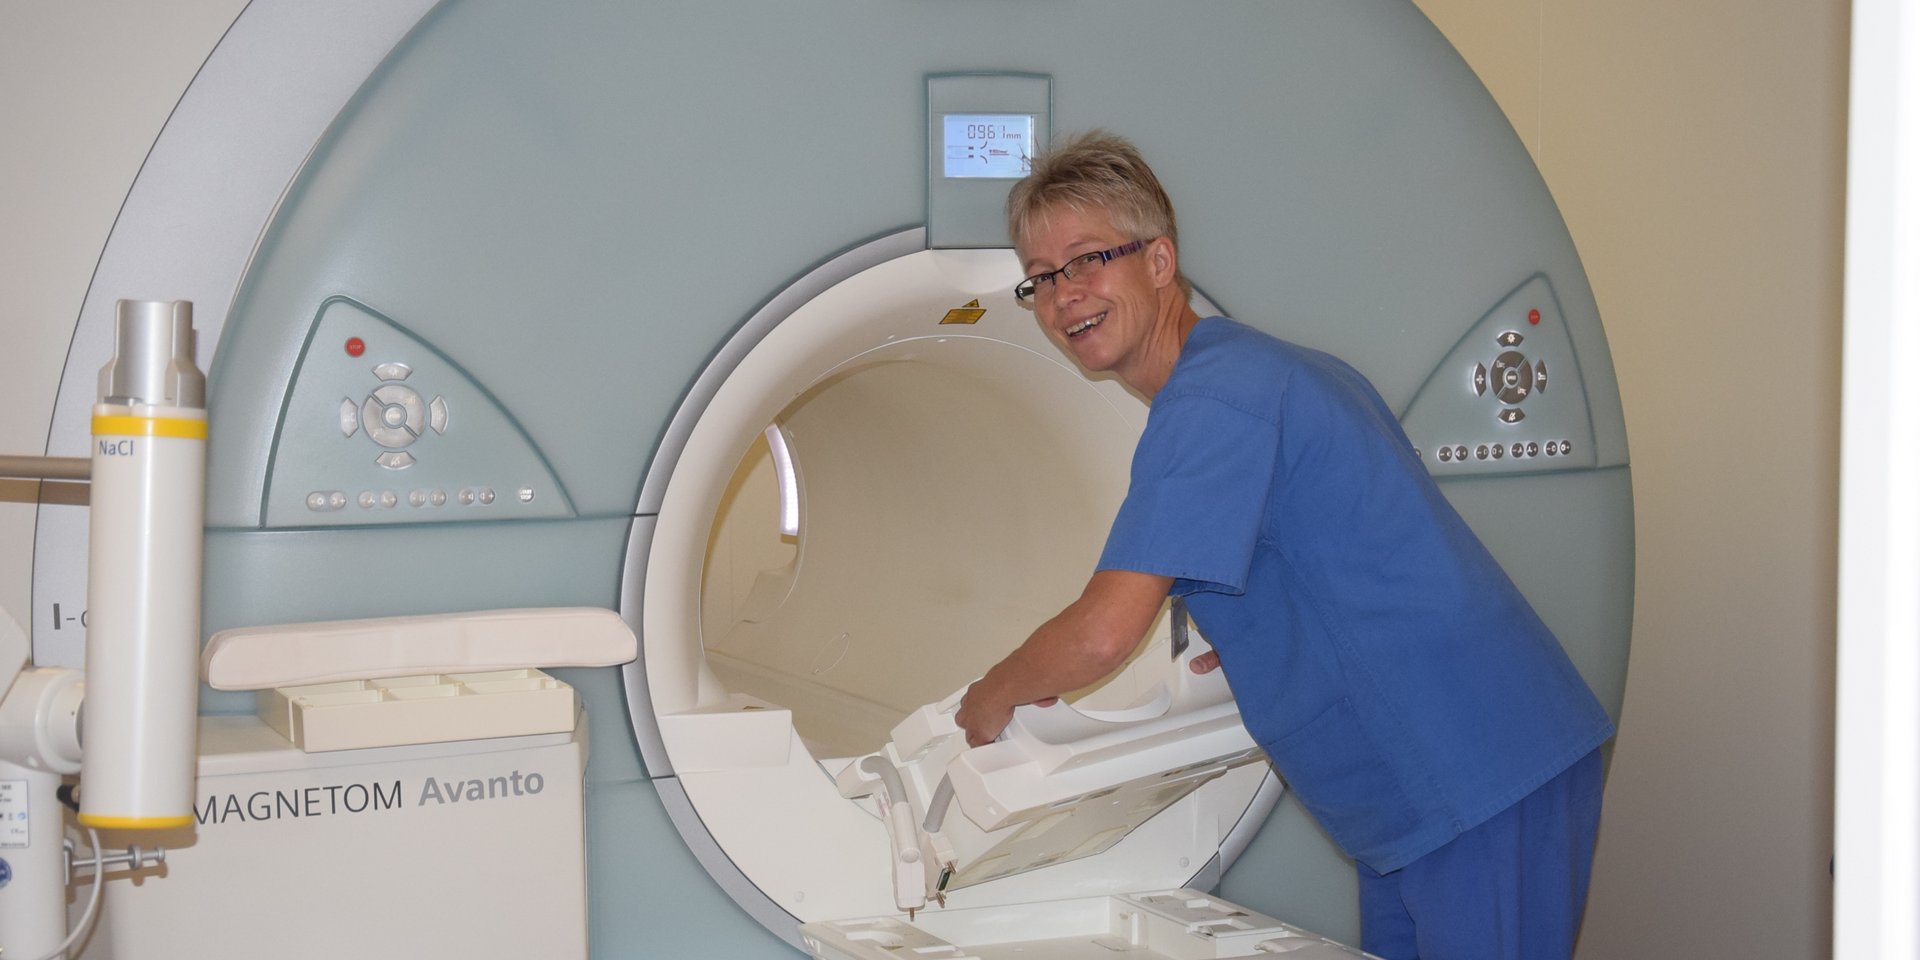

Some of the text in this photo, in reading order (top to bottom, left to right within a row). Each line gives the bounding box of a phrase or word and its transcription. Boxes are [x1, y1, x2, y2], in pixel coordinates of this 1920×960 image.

[98, 439, 134, 456] NaCl
[193, 769, 545, 825] MAGNETOM Avanto
